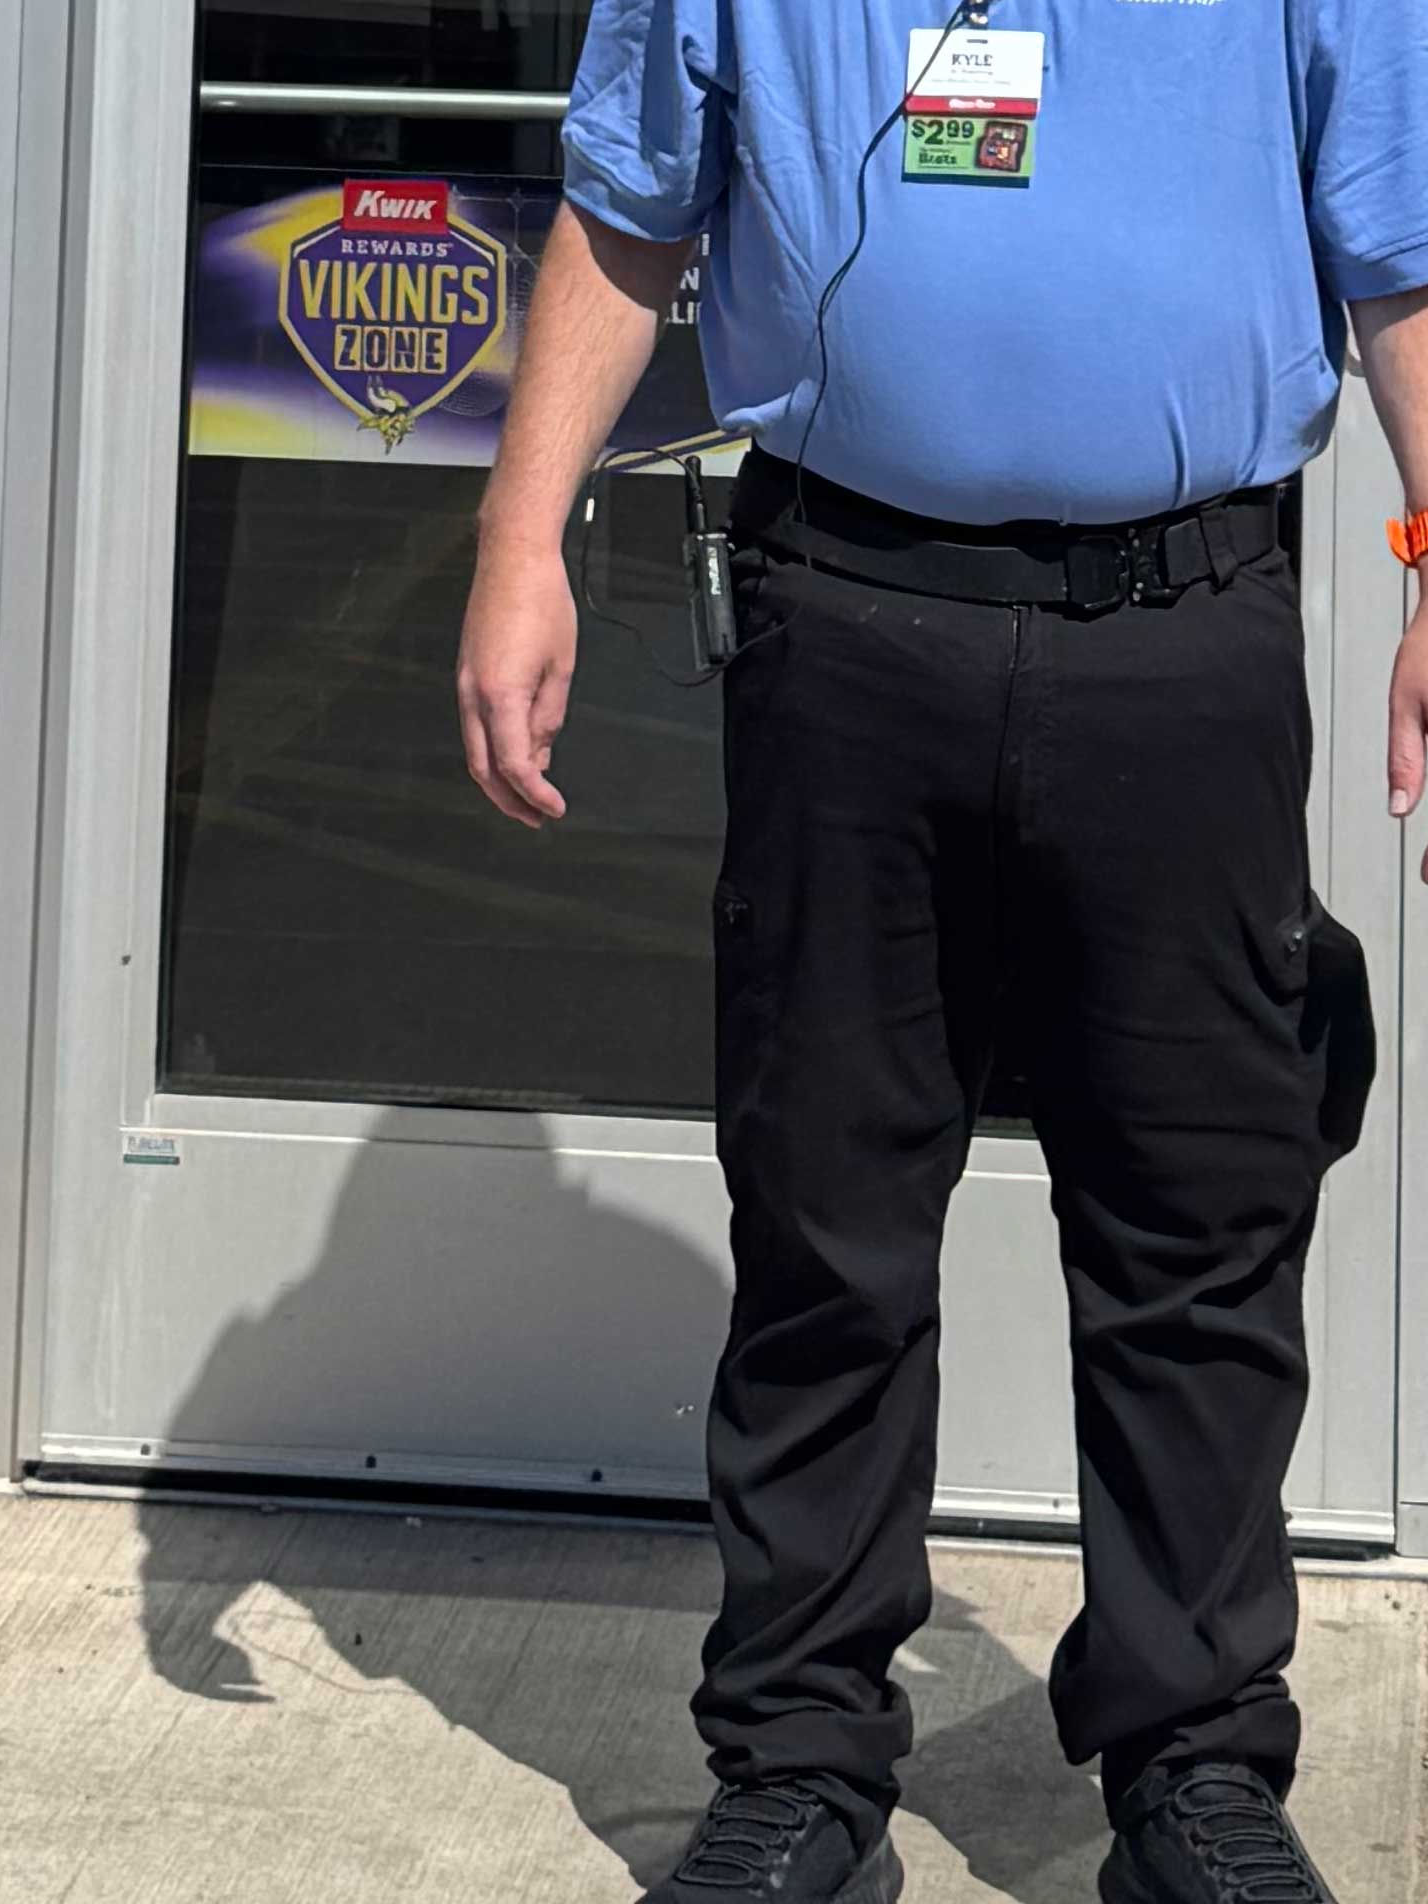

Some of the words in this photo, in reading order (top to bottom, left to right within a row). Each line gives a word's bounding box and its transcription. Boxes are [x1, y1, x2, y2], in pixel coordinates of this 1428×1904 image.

[951, 53, 994, 67] KYLE
[341, 238, 449, 258] REWARDS
[298, 259, 490, 326] VIKINGS
[338, 328, 445, 373] ZONE
